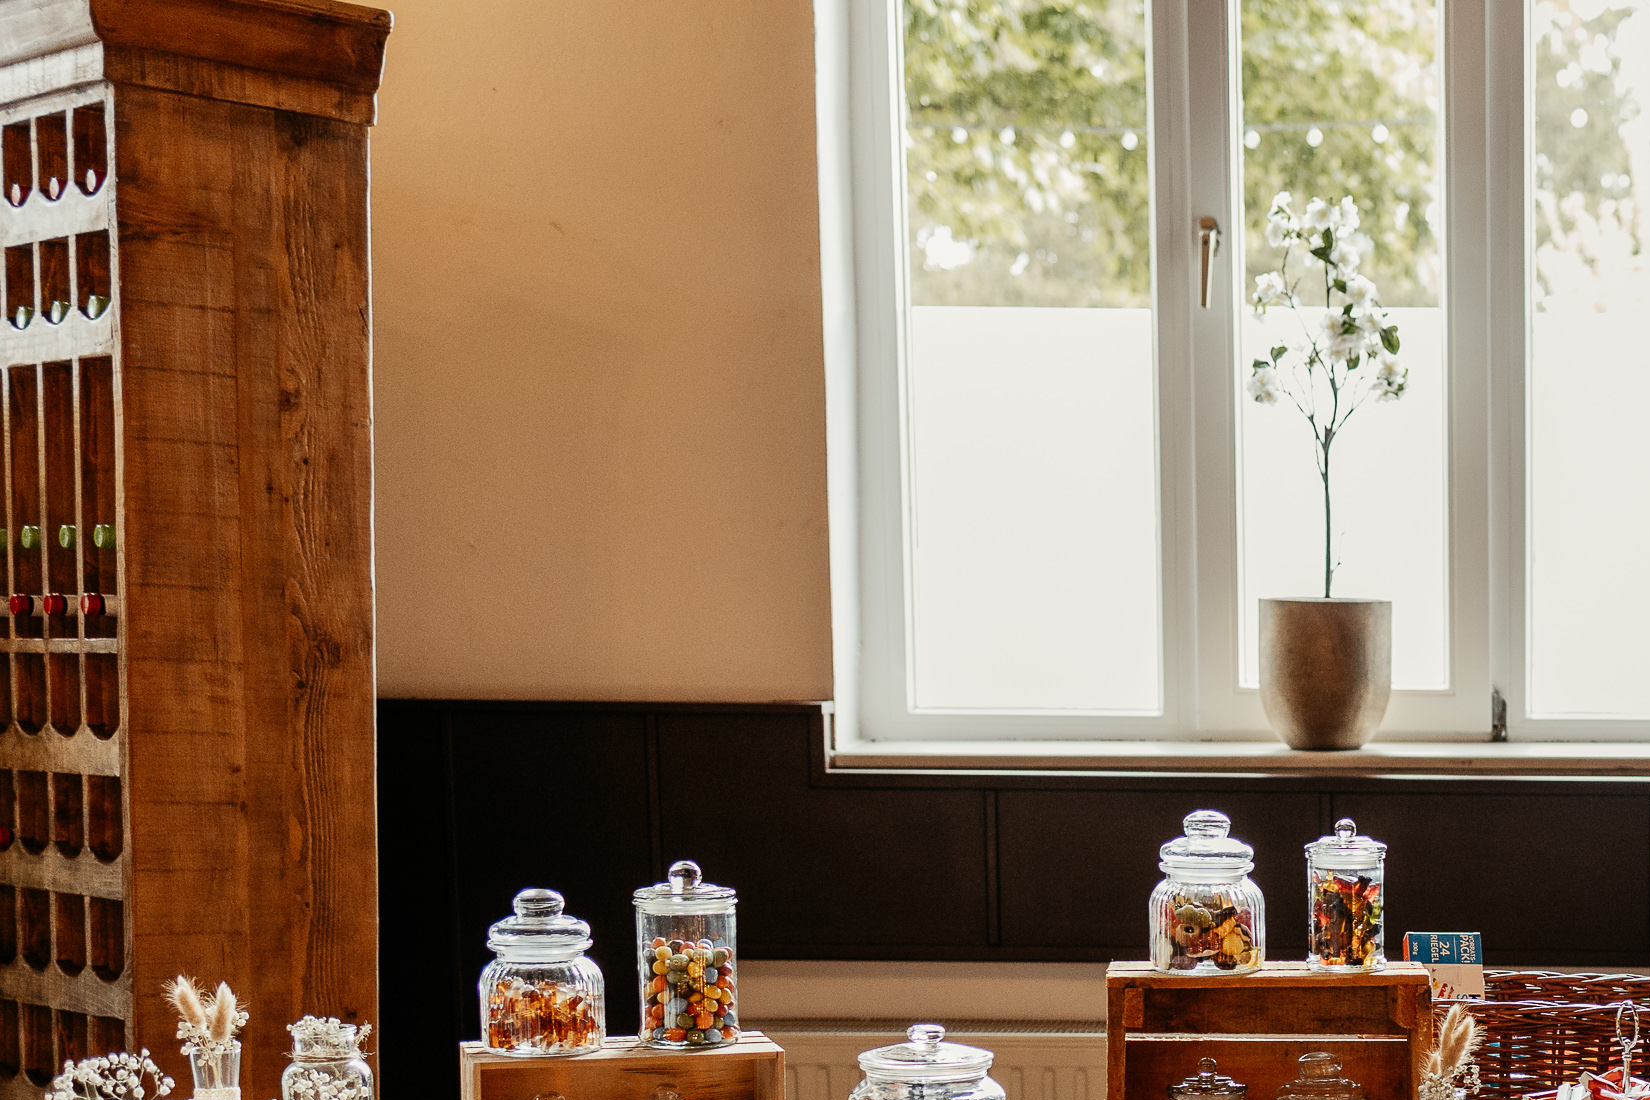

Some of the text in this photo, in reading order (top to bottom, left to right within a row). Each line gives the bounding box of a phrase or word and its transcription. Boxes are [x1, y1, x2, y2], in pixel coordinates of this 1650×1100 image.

[1430, 934, 1440, 963] RIEGEL
[1439, 941, 1450, 956] 24
[1459, 934, 1471, 963] PACK!
